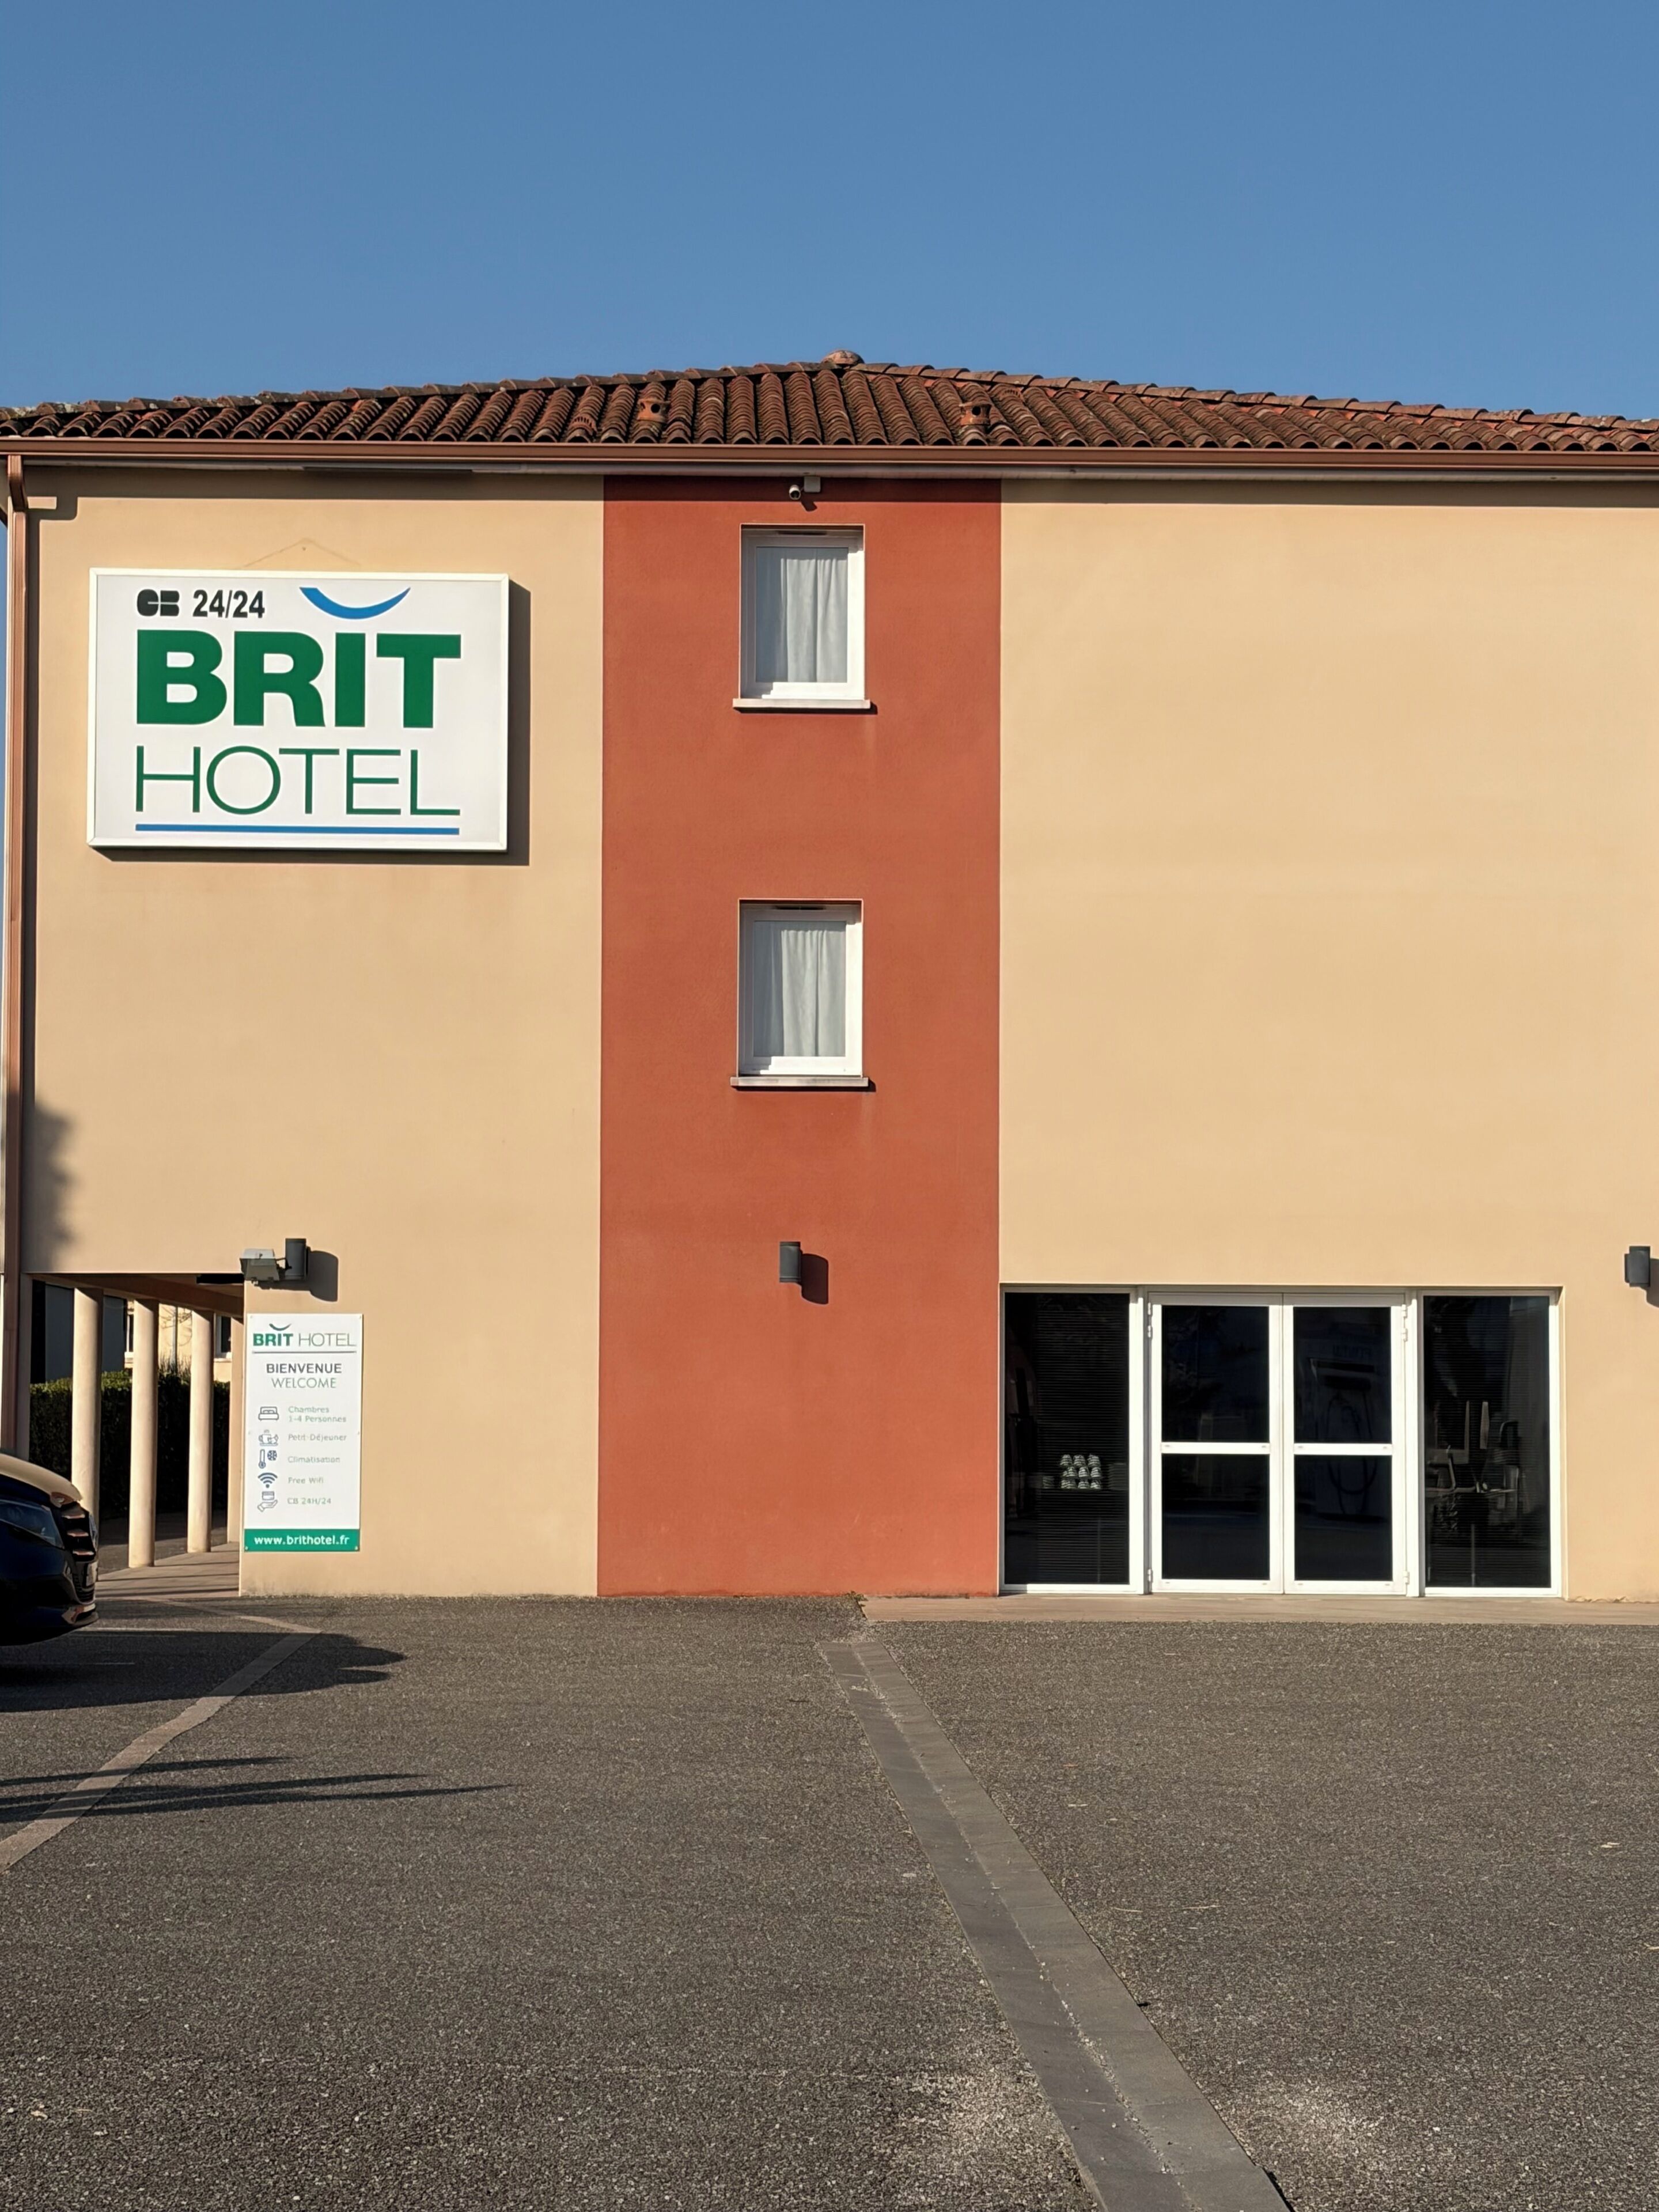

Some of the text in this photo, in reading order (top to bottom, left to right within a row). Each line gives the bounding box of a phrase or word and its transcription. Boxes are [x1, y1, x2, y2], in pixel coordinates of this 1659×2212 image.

[192, 589, 265, 619] 24/24
[137, 629, 461, 729] BRIT
[135, 745, 461, 816] HOTEL
[253, 1332, 357, 1347] BRIT HOTEL
[266, 1363, 342, 1374] BIENVENUE
[271, 1377, 336, 1388] WELCOME
[288, 1406, 329, 1414] Chambres
[301, 1497, 331, 1505] 24H/24
[254, 1535, 350, 1546] www.brithotel.fr
